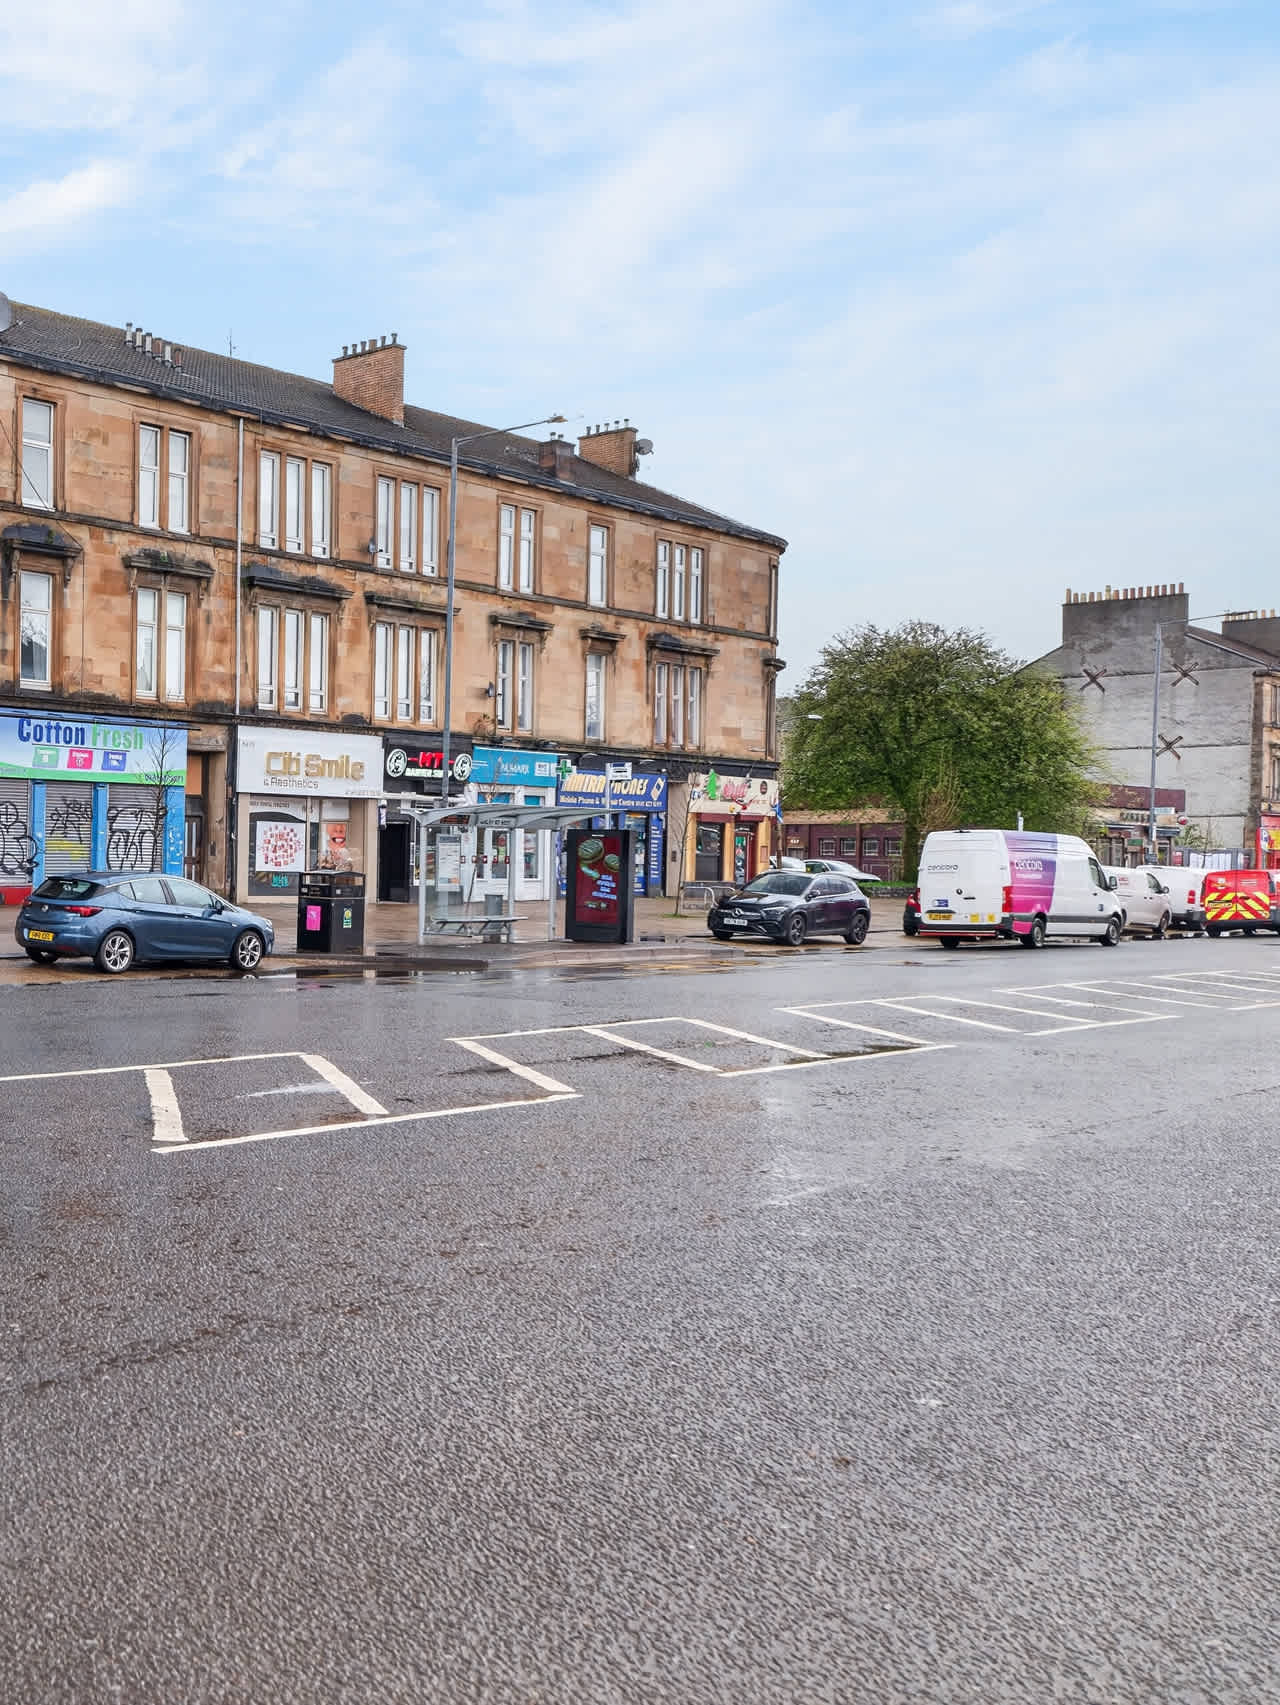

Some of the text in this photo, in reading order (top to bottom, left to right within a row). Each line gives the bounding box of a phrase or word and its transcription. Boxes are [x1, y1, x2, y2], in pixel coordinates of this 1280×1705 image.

[18, 717, 144, 750] Cotton Fresh
[304, 754, 365, 781] Smile
